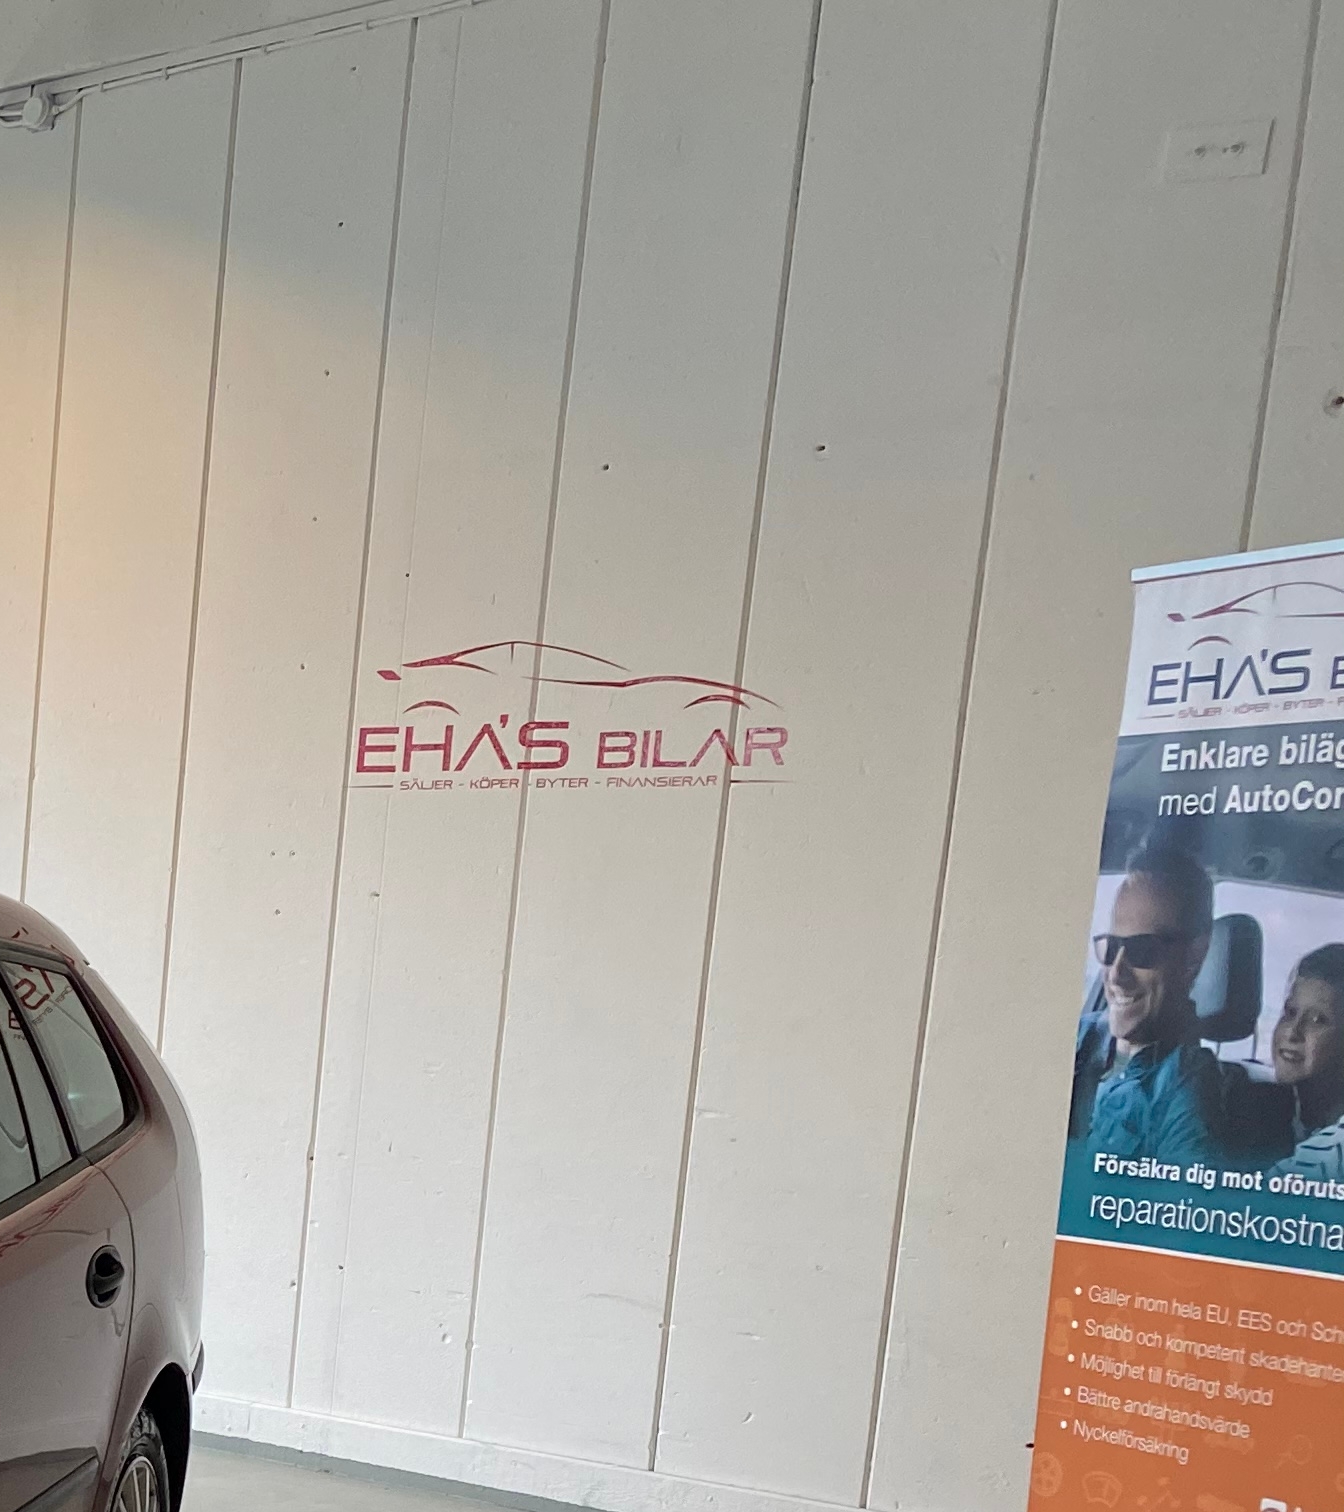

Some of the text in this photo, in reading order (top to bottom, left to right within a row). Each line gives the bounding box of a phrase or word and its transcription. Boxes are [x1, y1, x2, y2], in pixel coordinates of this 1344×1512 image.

[355, 714, 789, 773] EHA'S BILAR
[1161, 740, 1270, 772] Enklare
[470, 776, 519, 789] KÖPER
[536, 777, 588, 788] BYTER
[607, 775, 717, 787] FINANSIERAR
[1158, 786, 1217, 816] med
[1094, 1153, 1181, 1182] Försäkra
[1186, 1162, 1217, 1190] dig
[1222, 1171, 1263, 1191] mot
[1089, 1194, 1344, 1251] reparationskostna
[1088, 1285, 1131, 1307] Gäller
[1134, 1293, 1168, 1314] inom
[1172, 1298, 1201, 1320] hela
[1237, 1310, 1272, 1332] EES
[1276, 1319, 1307, 1338] och
[1085, 1319, 1133, 1343] Snabb
[1136, 1331, 1162, 1348] och
[1166, 1334, 1246, 1364] kompetent
[1081, 1352, 1274, 1406] Möjlighet till förlängt skydd
[1077, 1386, 1251, 1439] Bättre andrahandsvärde
[1073, 1419, 1189, 1465] Nyckelförsäkring
